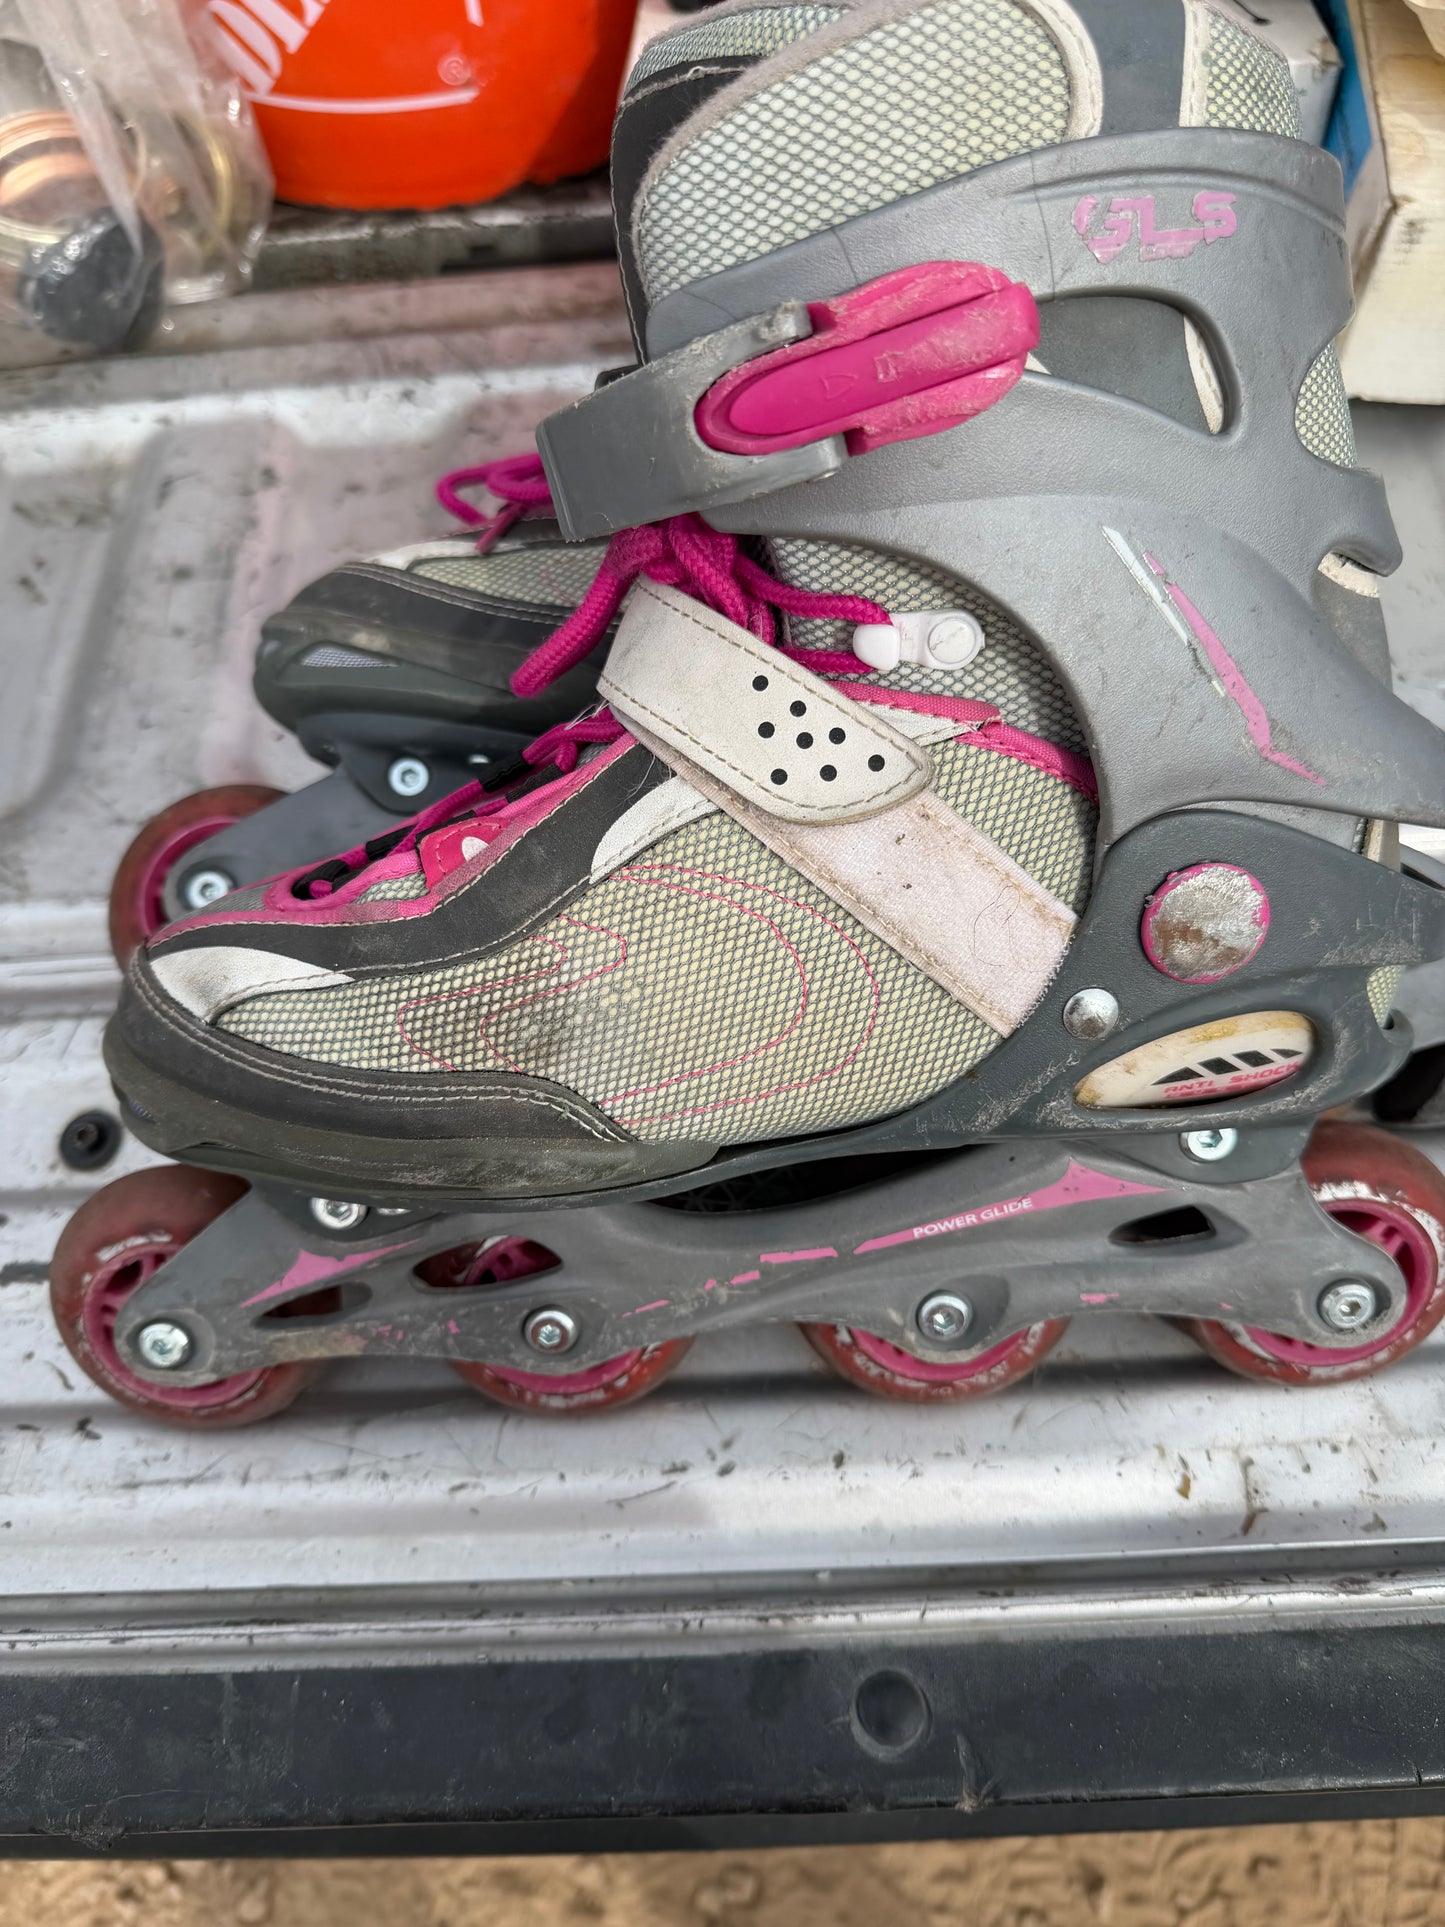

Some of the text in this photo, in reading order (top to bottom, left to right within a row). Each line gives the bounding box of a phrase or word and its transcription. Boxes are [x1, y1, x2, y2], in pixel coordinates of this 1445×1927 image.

[1072, 191, 1238, 263] GLS
[1163, 1079, 1214, 1094] ANTI
[1229, 1061, 1301, 1084] SHOCK
[912, 1197, 1033, 1238] POWER GLIDE
